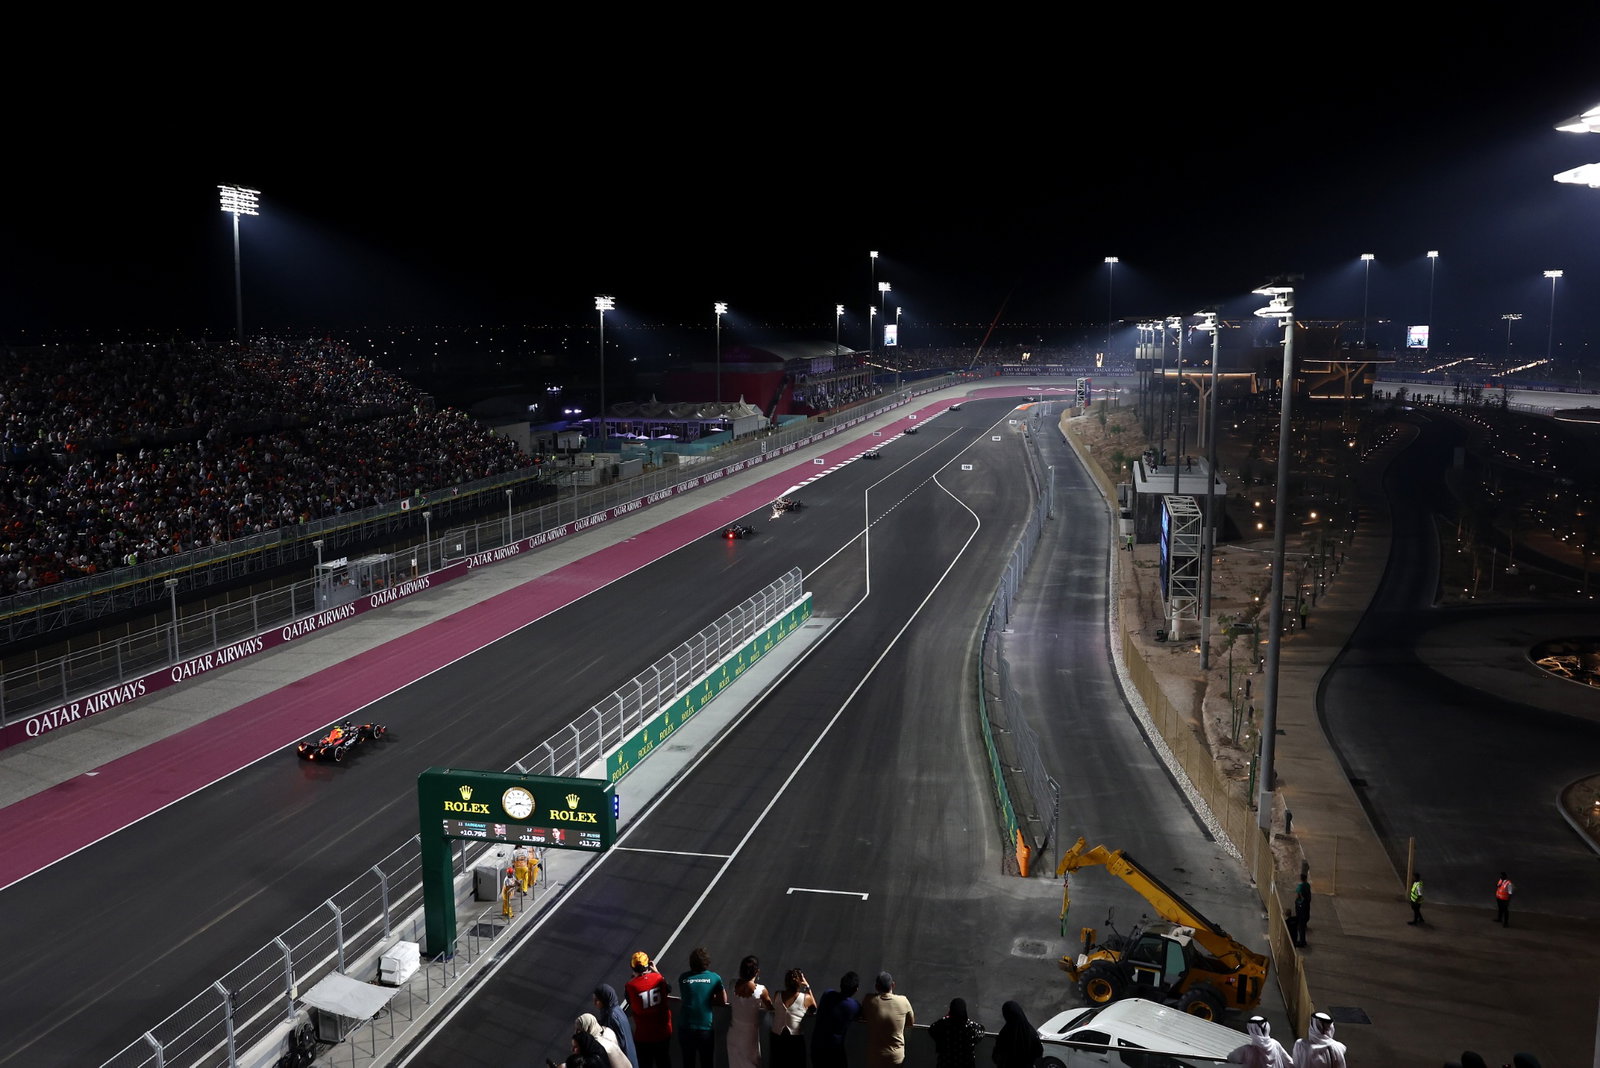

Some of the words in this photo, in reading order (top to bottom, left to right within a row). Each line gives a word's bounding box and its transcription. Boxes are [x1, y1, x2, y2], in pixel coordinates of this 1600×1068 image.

[574, 518, 589, 532] QATAR
[590, 512, 607, 524] AIRWAYS
[529, 536, 546, 548] QATAR
[547, 526, 567, 543] AIRWAYS
[466, 552, 492, 568] QATAR
[494, 544, 520, 561] AIRWAYS
[370, 588, 397, 607] QATAR
[399, 576, 430, 597] AIRWAYS
[282, 617, 315, 641] QATAR
[318, 602, 355, 628] AIRWAYS
[172, 654, 213, 682] QATAR
[216, 636, 263, 666] AIRWAYS
[26, 704, 81, 737] QATAR
[84, 679, 146, 716] AIRWAYS
[701, 690, 713, 705] ROLEX
[681, 705, 695, 722] ROLEX
[659, 722, 675, 741] ROLEX
[638, 740, 654, 759] ROLEX
[612, 761, 629, 782] ROLEX
[444, 801, 490, 814] ROLEX
[550, 810, 597, 823] ROLEX
[638, 987, 662, 1008] 16
